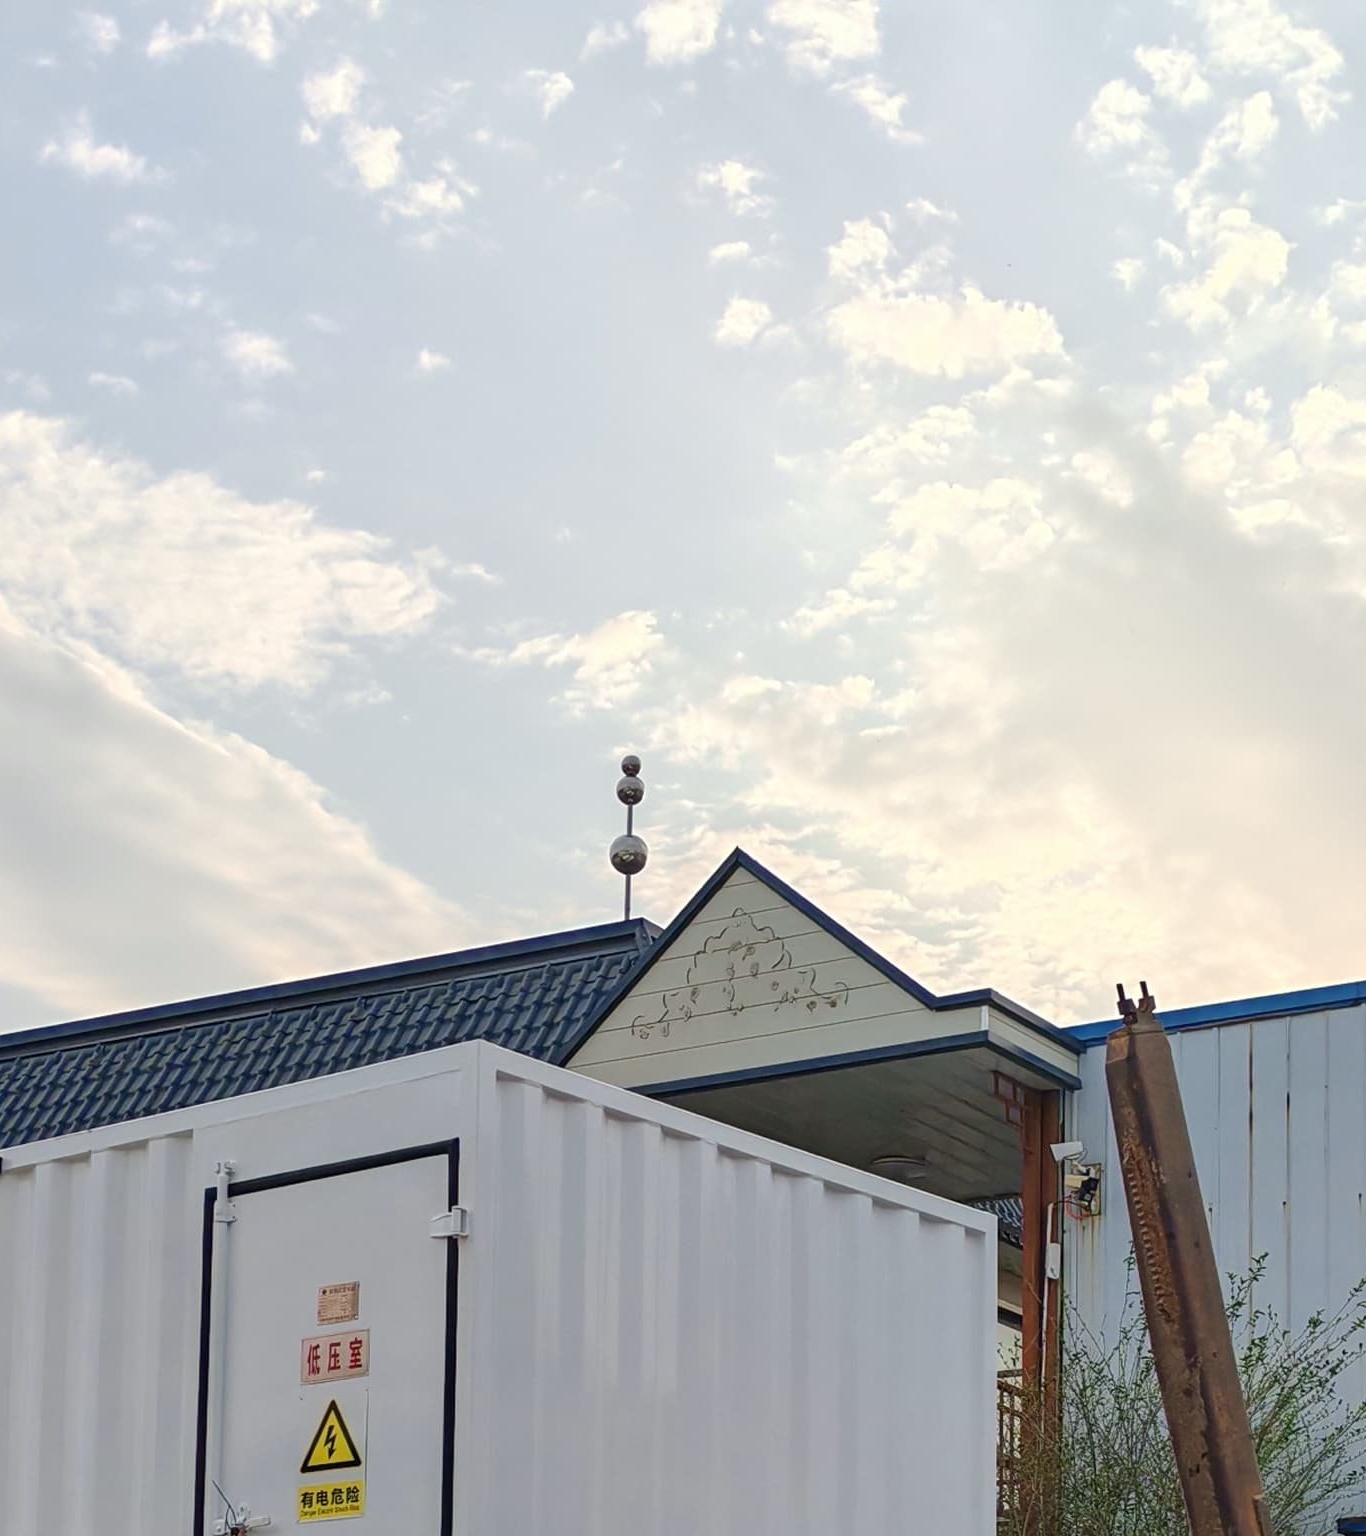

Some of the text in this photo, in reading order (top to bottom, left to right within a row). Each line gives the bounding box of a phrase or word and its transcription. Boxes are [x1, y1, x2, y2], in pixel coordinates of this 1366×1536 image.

[307, 1337, 362, 1376] 低压室
[301, 1486, 360, 1509] 有电危险
